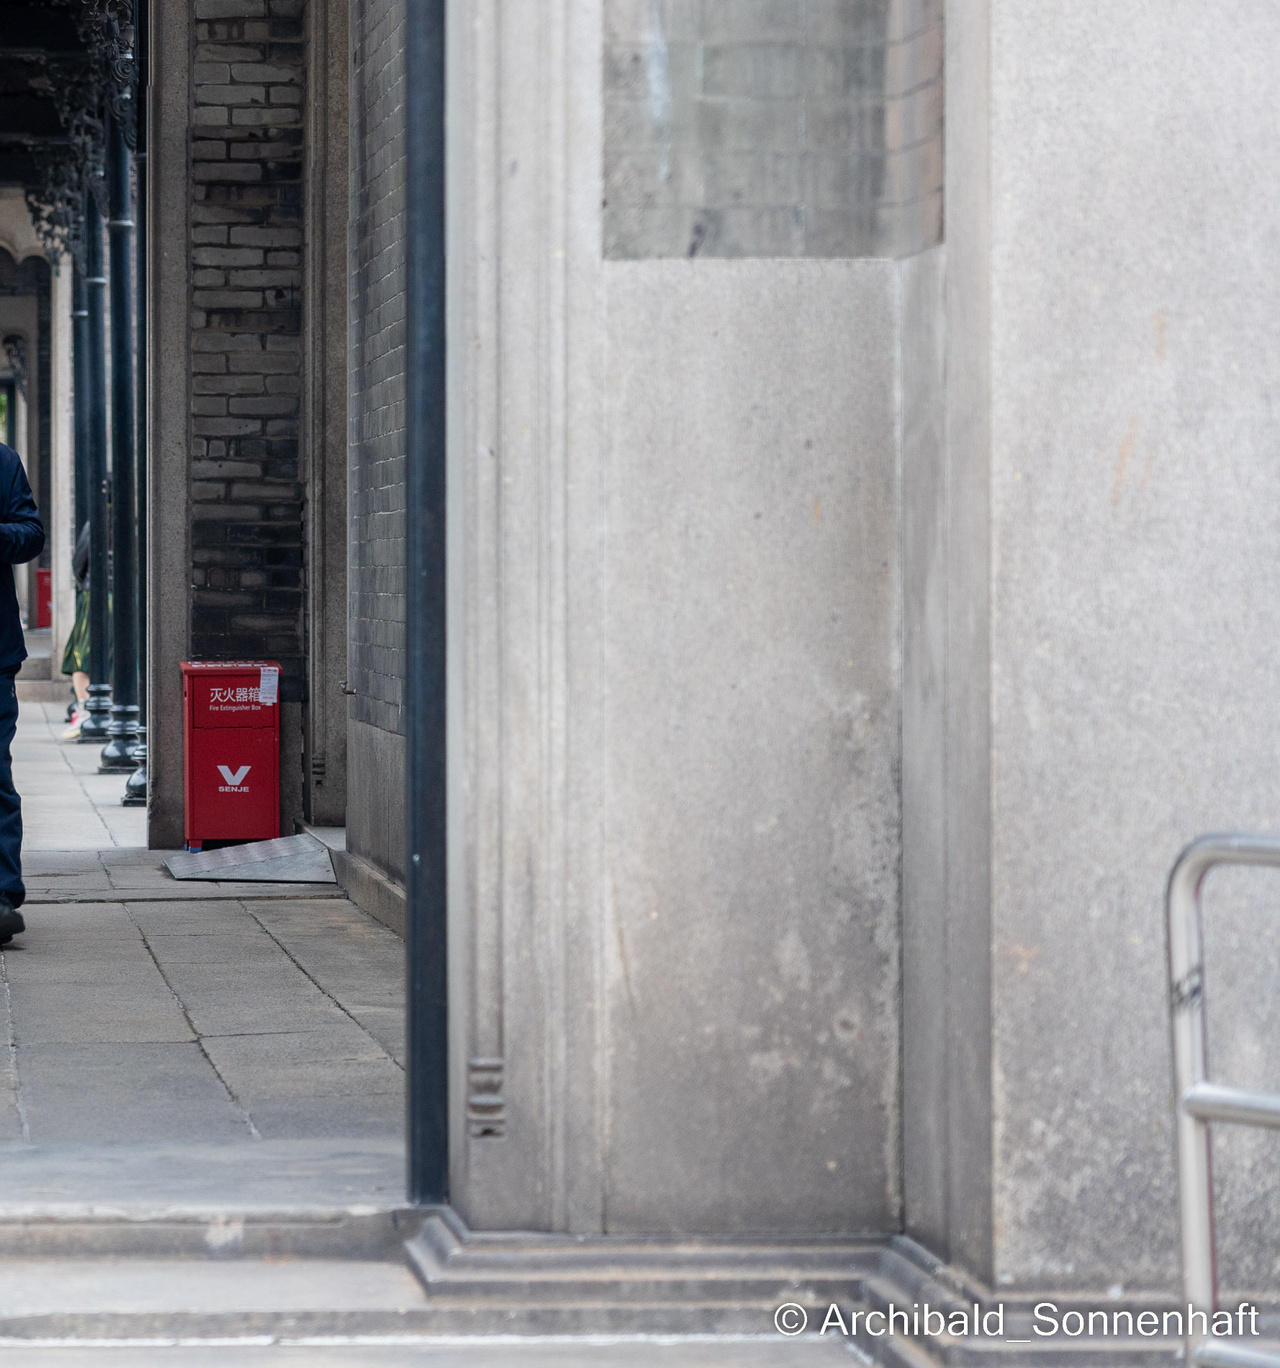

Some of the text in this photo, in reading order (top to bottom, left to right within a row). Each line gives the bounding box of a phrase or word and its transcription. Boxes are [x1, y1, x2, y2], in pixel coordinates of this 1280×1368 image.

[210, 687, 260, 703] 灭火器箱
[220, 704, 251, 712] Extinguisher
[218, 785, 250, 793] SENJE
